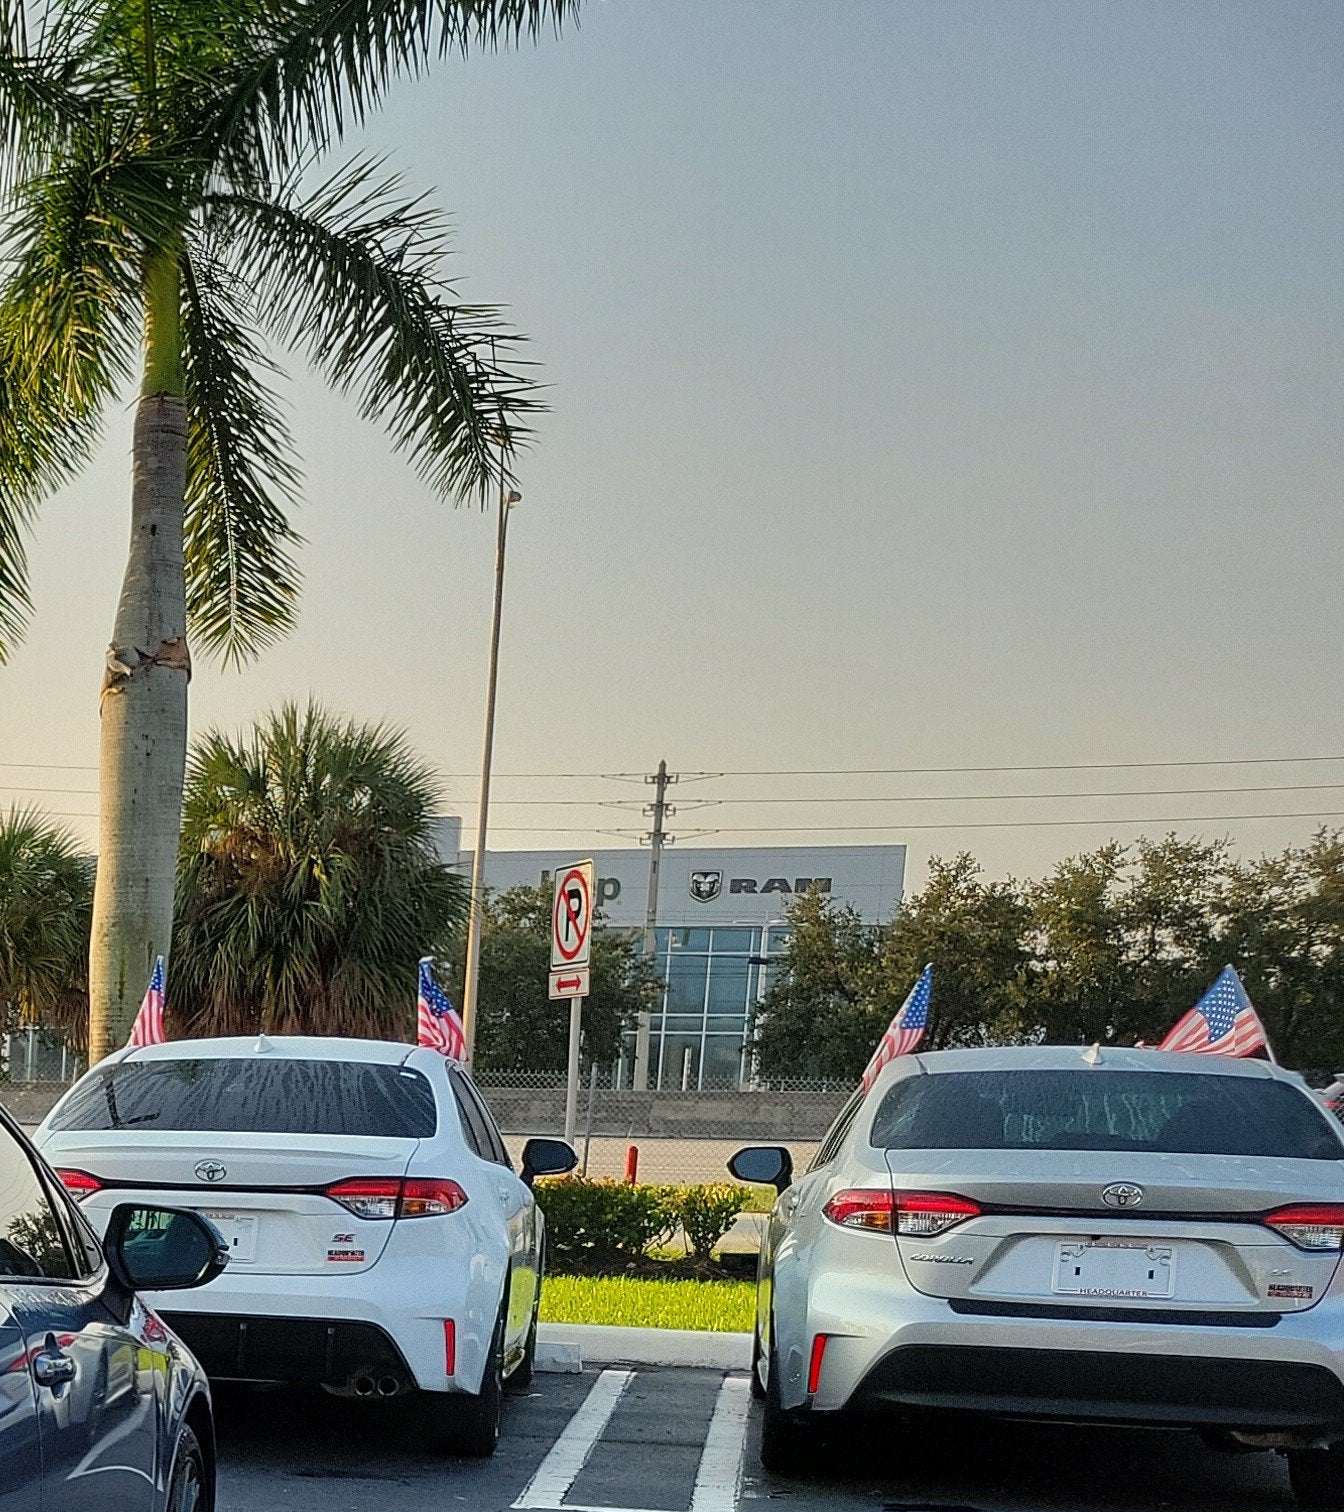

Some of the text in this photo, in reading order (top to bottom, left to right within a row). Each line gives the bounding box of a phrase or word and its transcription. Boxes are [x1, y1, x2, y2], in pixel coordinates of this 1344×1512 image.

[729, 877, 832, 894] RAM
[910, 1253, 973, 1265] COROLLA
[1079, 1287, 1149, 1297] HEADQUARTER
